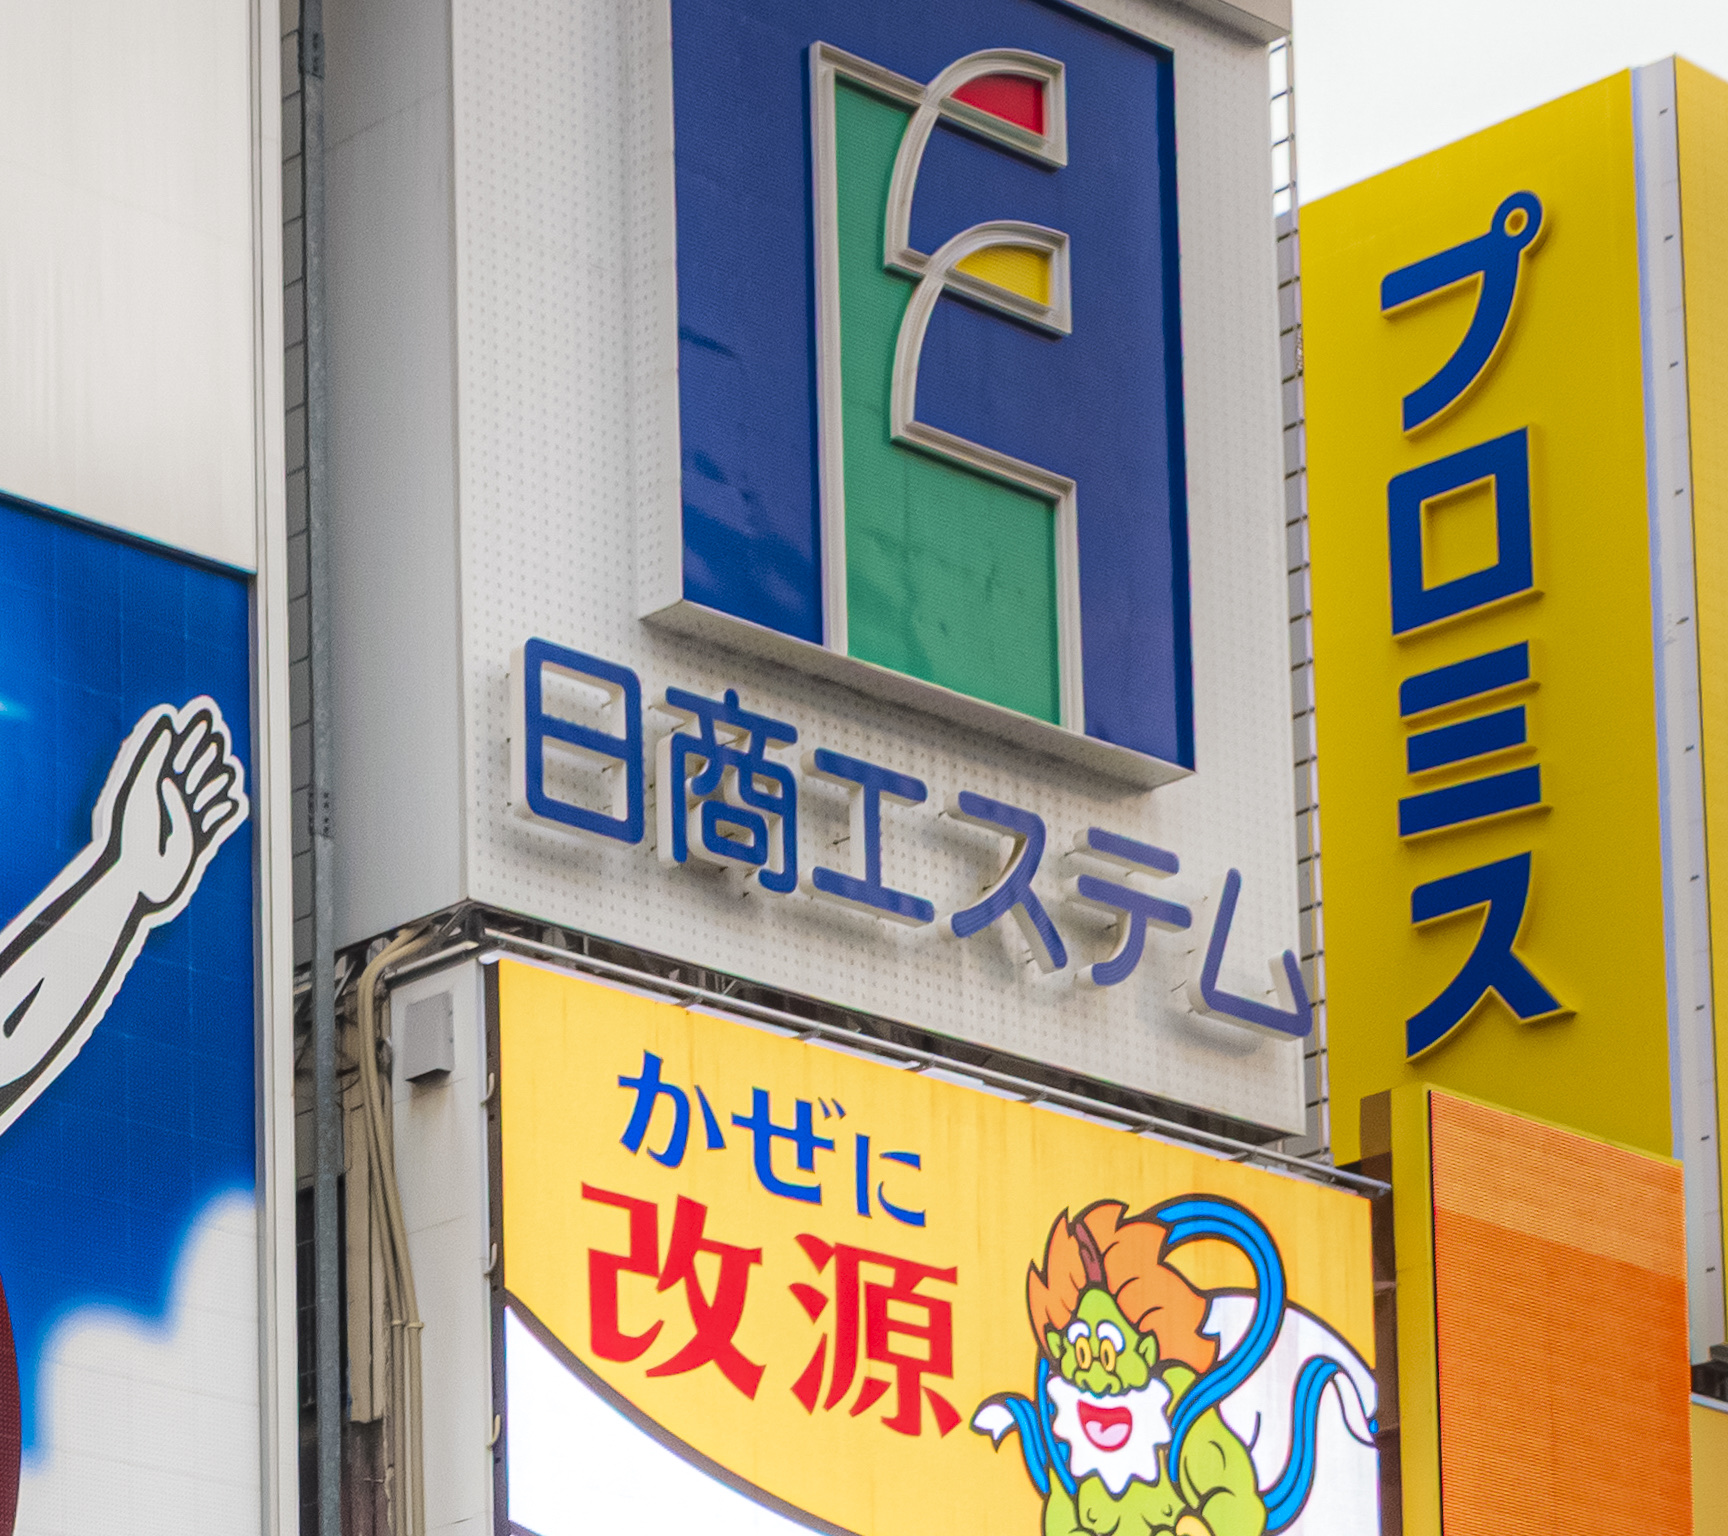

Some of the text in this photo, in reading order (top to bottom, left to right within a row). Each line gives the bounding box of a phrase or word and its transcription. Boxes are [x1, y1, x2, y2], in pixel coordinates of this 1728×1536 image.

[1381, 188, 1575, 1061] プロミス
[513, 636, 1314, 1040] 日商エステム
[618, 1049, 927, 1229] かぜに
[581, 1182, 962, 1440] 改源
